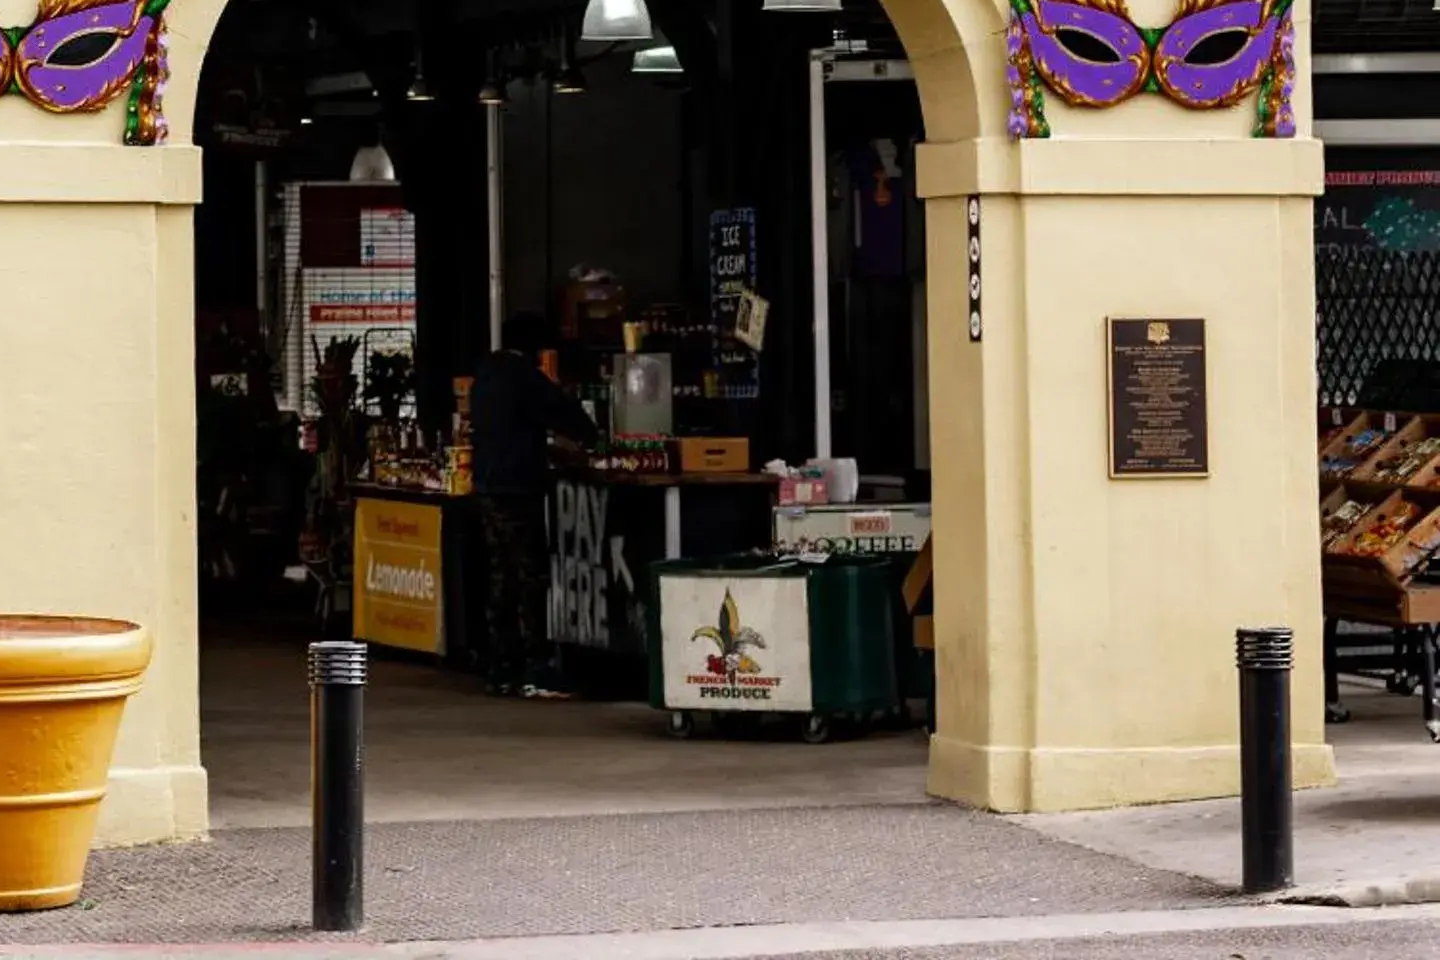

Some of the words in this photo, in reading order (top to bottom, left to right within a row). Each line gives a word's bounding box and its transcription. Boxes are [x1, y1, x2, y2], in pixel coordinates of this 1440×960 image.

[720, 224, 741, 247] ICE
[716, 253, 747, 276] CREAM
[556, 480, 609, 566] PAY
[365, 553, 436, 601] Lemonade
[546, 554, 610, 649] HERE
[687, 675, 728, 685] FRENCH
[737, 676, 783, 687] MARKET
[699, 686, 771, 700] PRODUCE
